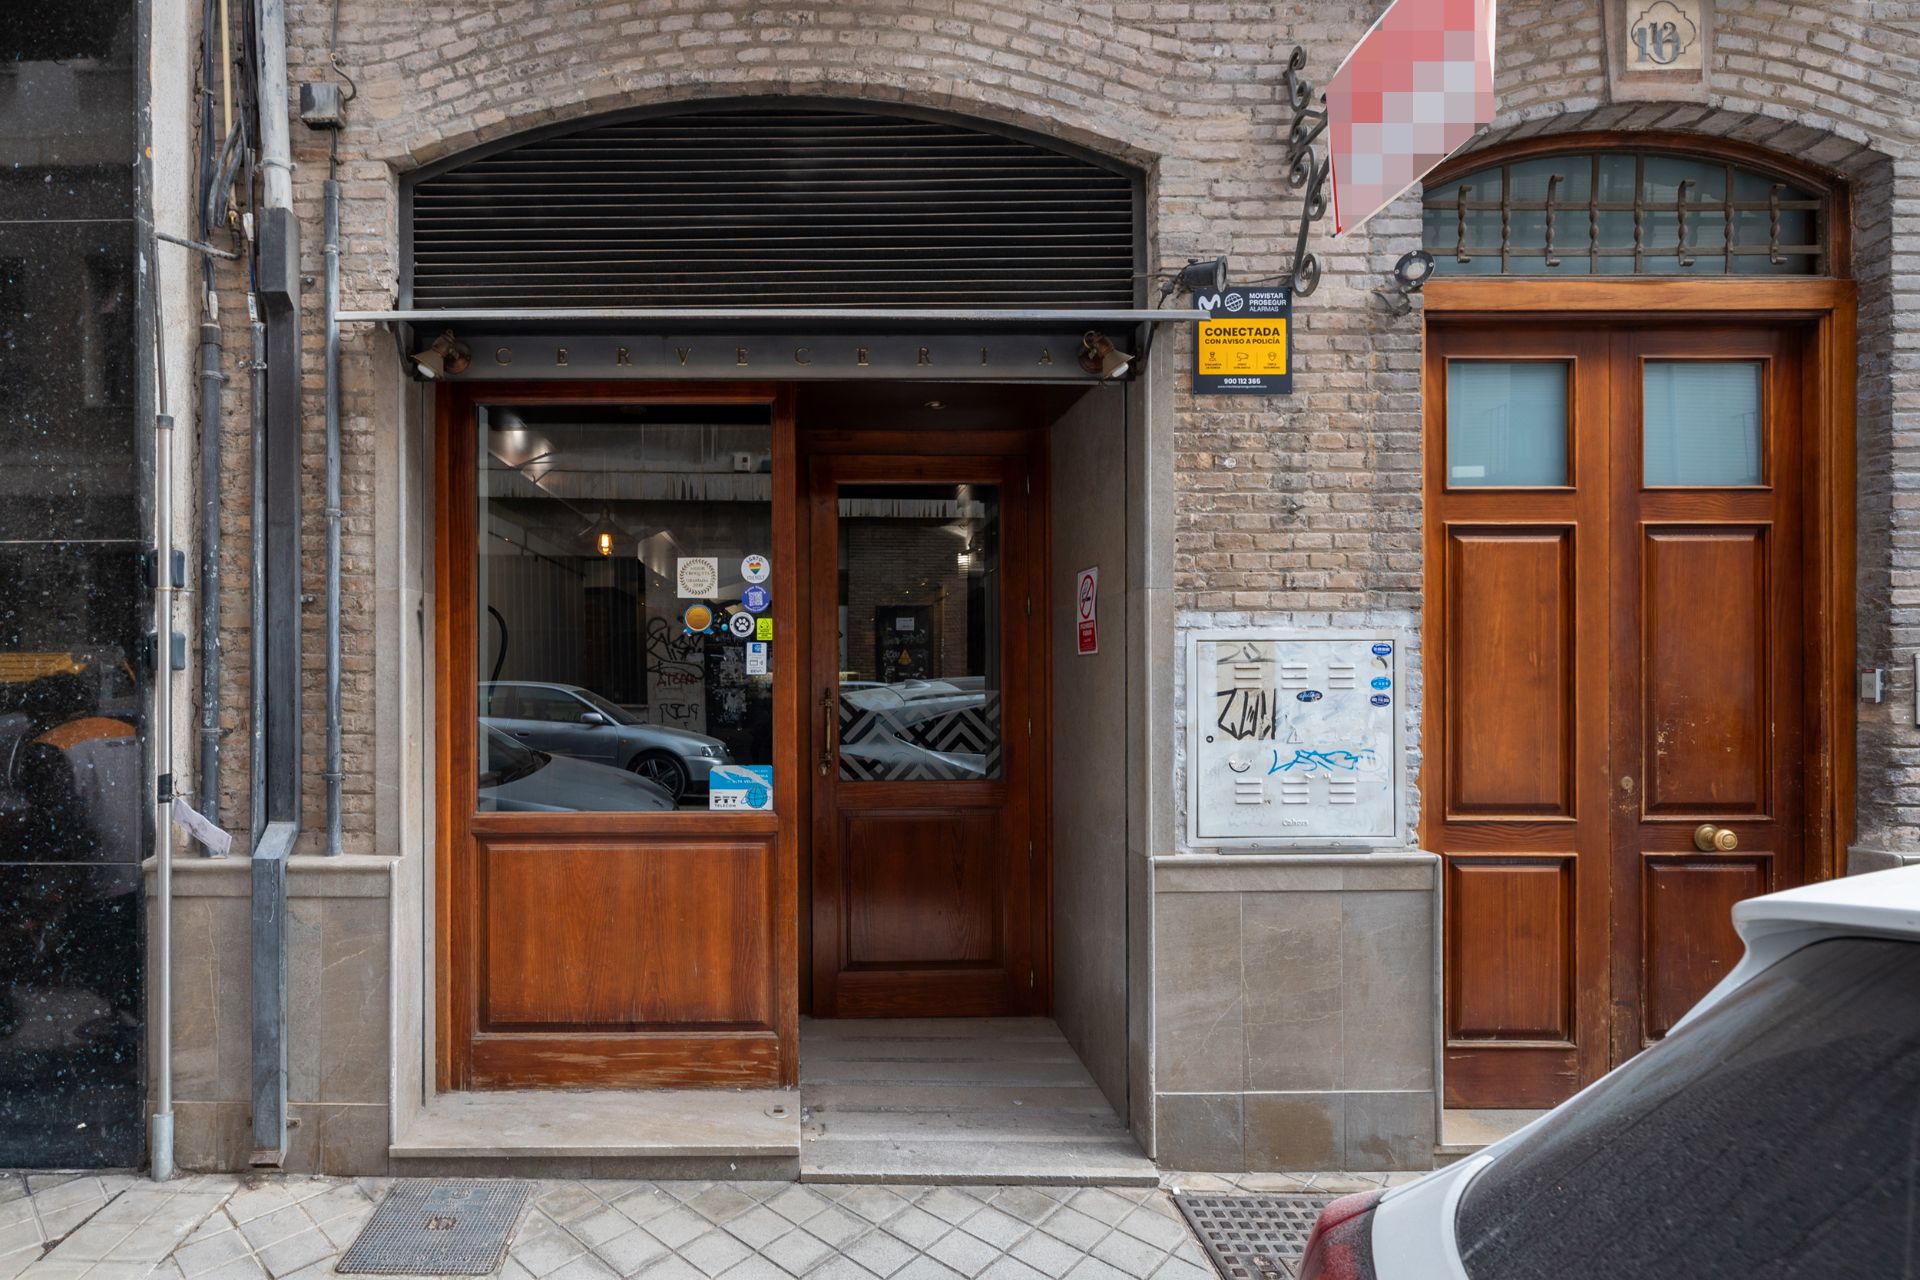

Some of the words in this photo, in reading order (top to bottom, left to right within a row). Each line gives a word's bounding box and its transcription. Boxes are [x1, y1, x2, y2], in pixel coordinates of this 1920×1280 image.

[1204, 327, 1281, 336] CONECTADA
[1252, 336, 1280, 344] POLICÍA
[1223, 377, 1237, 385] 900
[1237, 377, 1247, 385] 112
